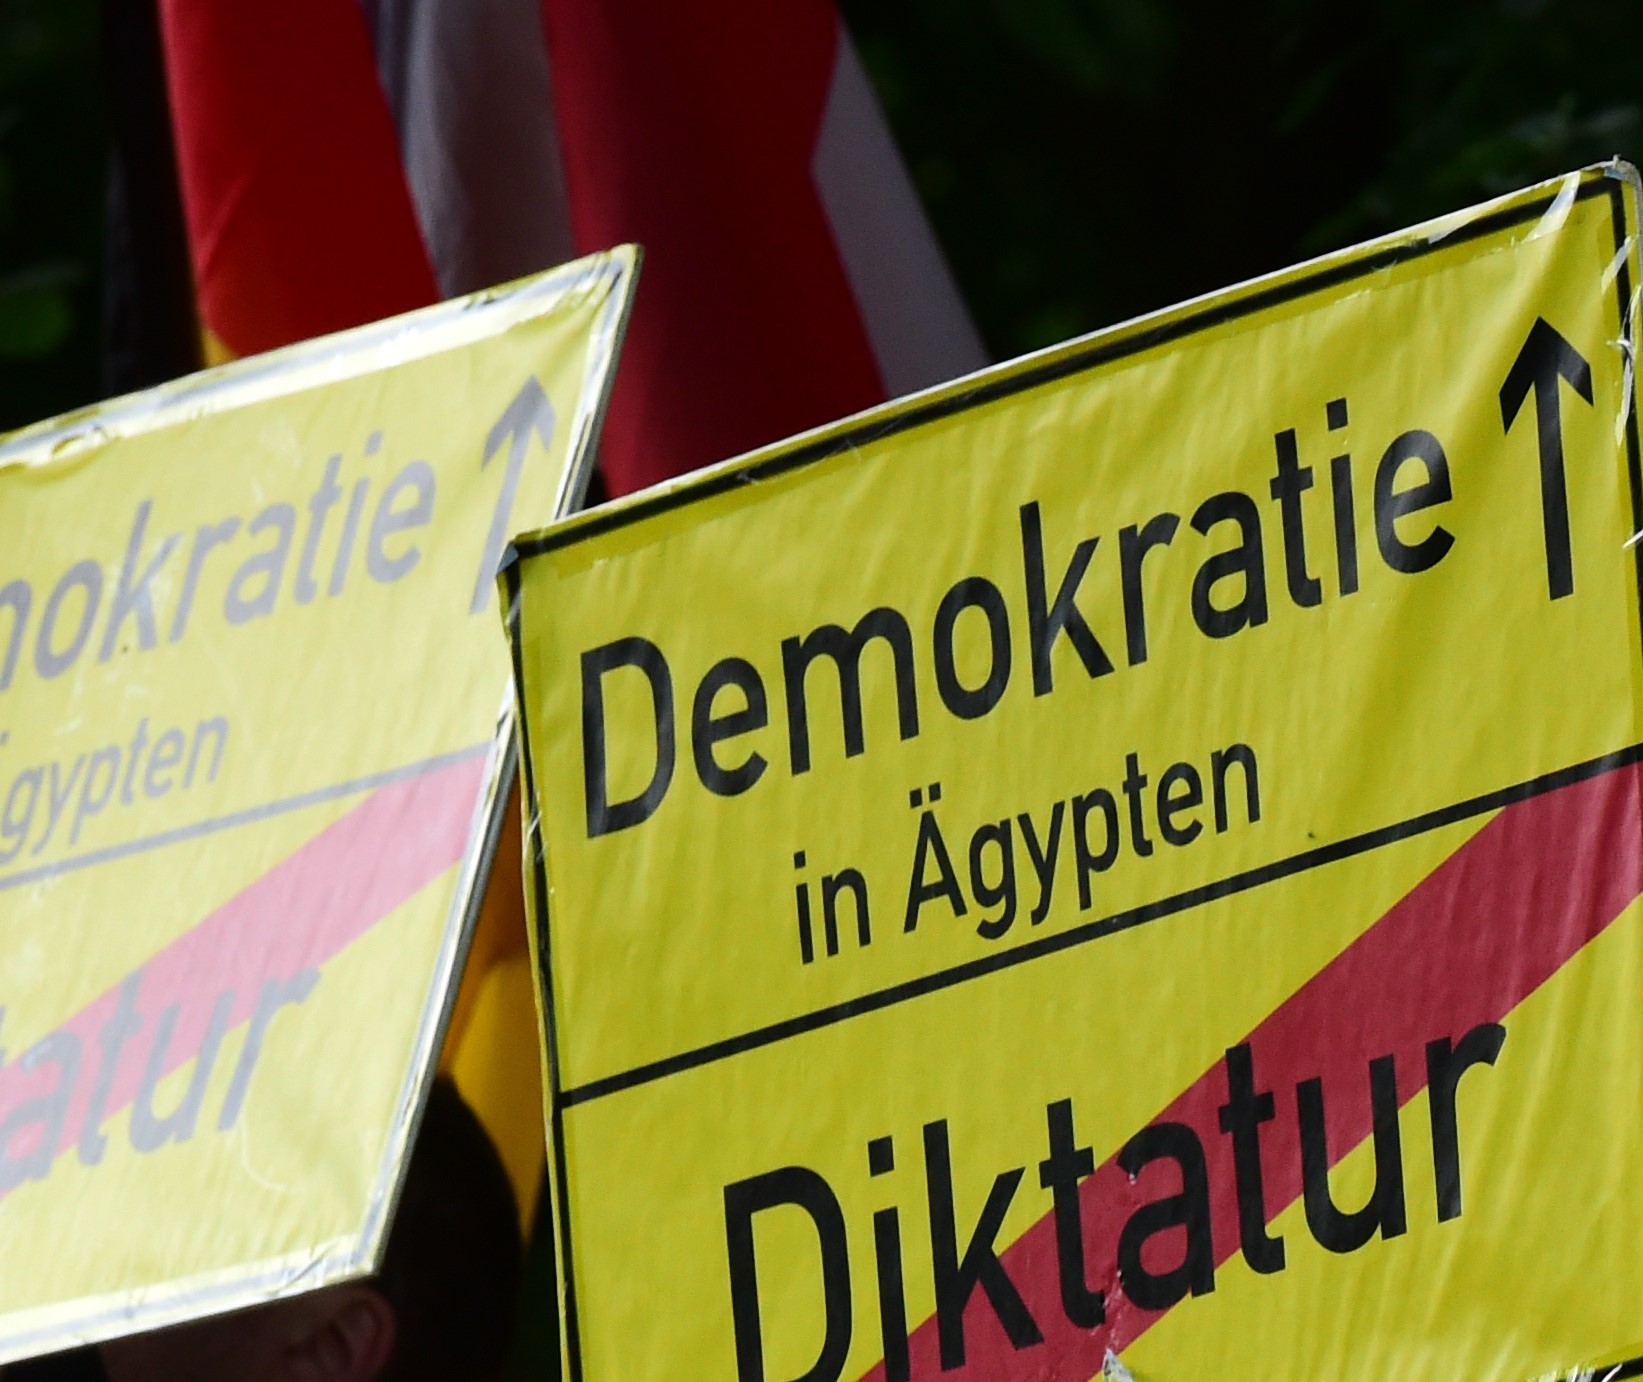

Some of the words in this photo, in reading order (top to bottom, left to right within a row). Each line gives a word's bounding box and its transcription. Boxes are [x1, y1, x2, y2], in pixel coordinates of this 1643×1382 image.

[580, 397, 1458, 840] Demokratie
[0, 714, 229, 867] gypten
[793, 854, 872, 965] in
[903, 743, 1262, 940] Ägypten
[0, 966, 321, 1190] atur
